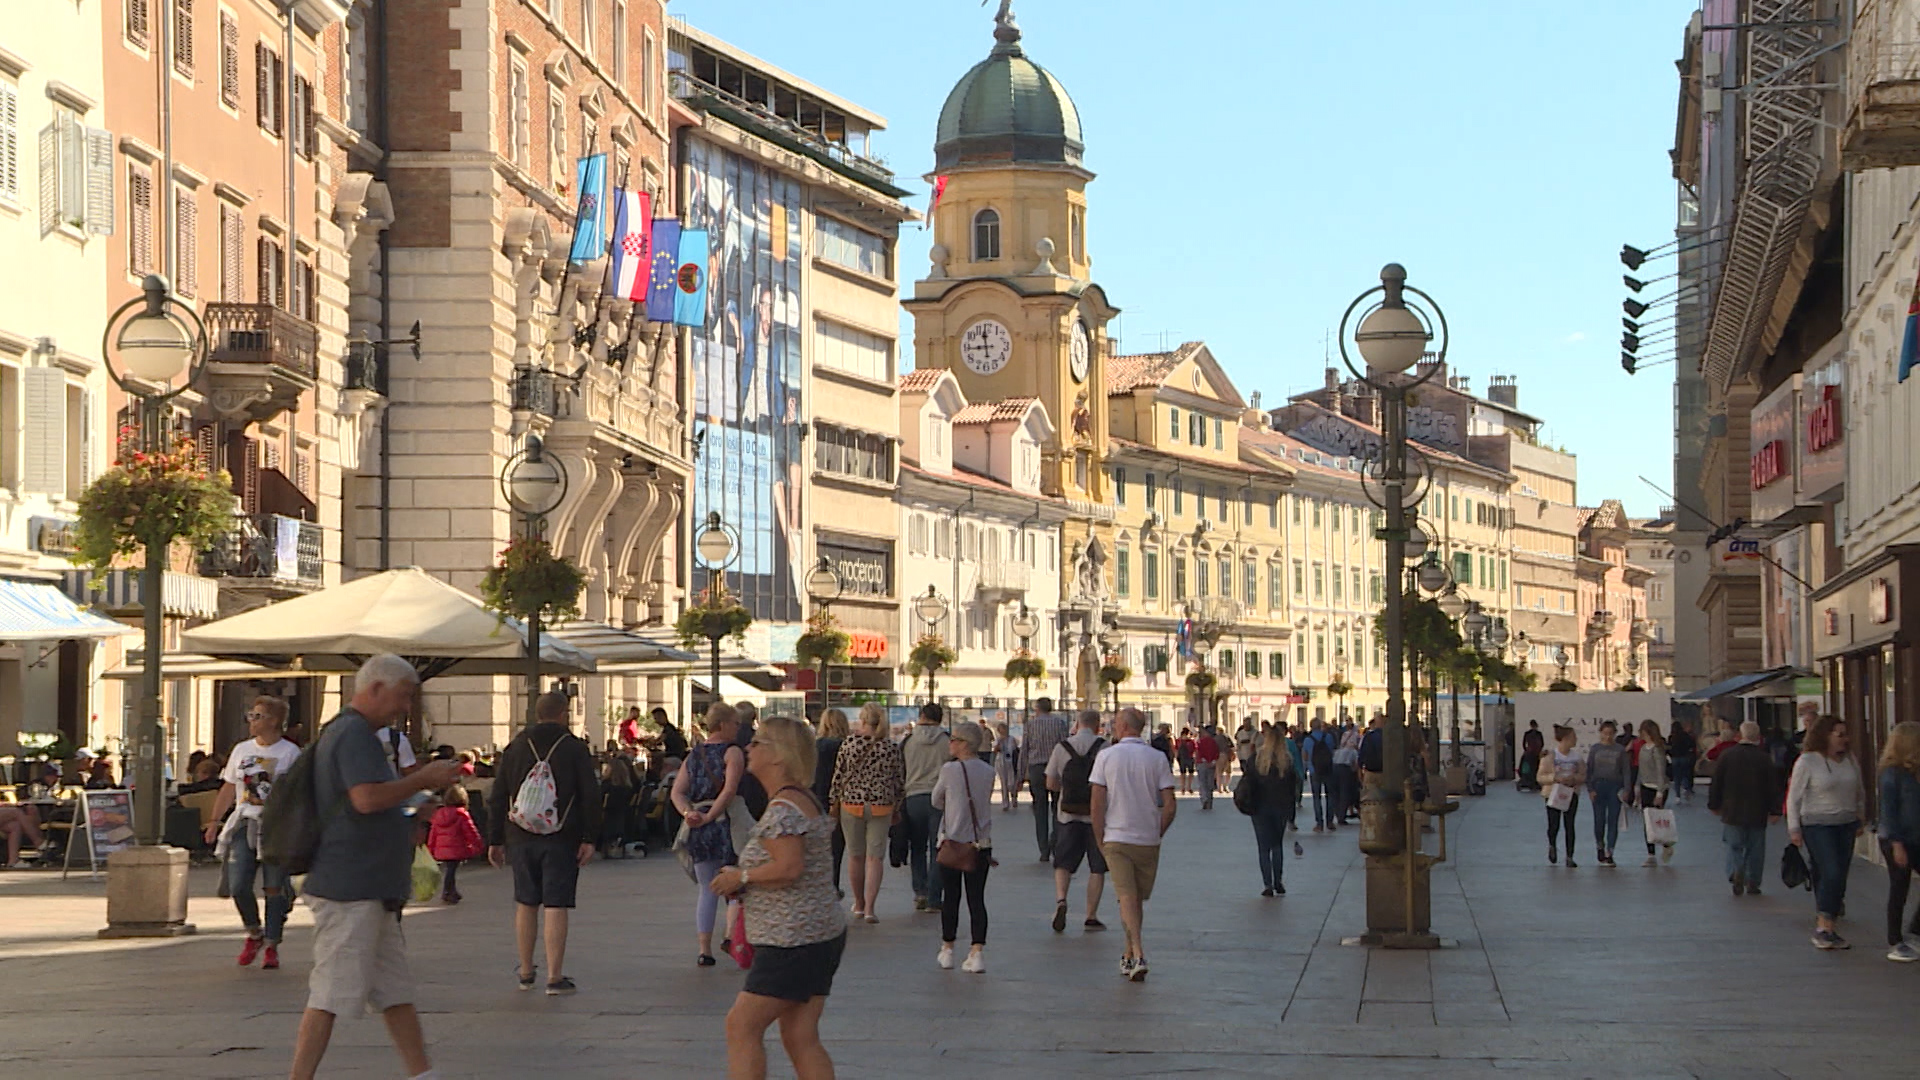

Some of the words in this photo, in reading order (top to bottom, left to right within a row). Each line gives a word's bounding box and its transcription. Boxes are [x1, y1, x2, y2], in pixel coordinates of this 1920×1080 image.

[967, 331, 976, 341] 10
[1003, 341, 1010, 352] 3
[967, 353, 975, 364] 8
[982, 361, 990, 372] 6
[992, 359, 999, 370] 5
[838, 557, 883, 584] moderato
[847, 631, 889, 659] ORZO
